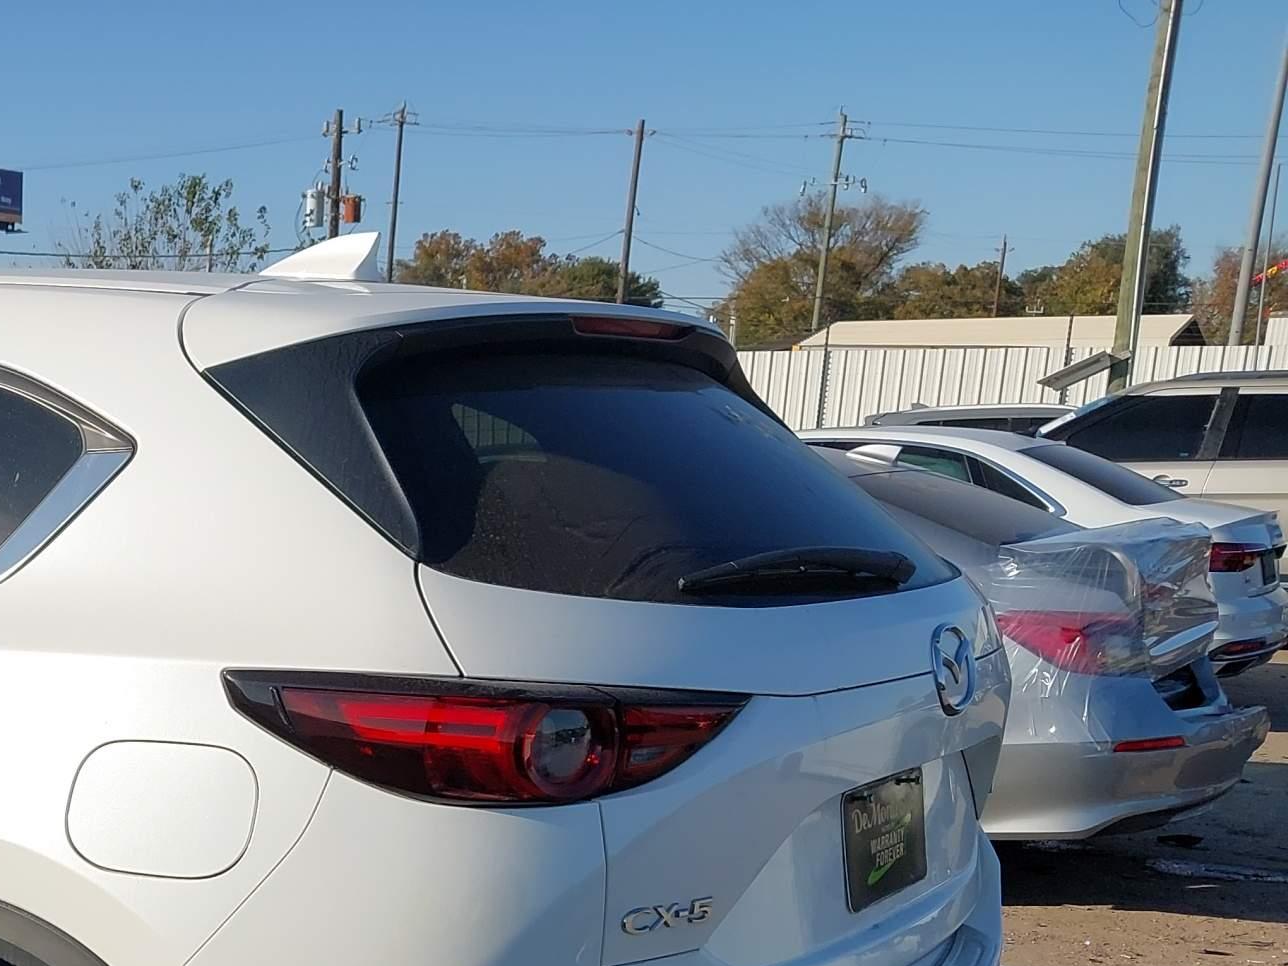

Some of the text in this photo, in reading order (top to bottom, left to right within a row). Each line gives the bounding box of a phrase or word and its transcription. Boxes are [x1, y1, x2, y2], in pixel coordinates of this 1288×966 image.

[870, 827, 904, 854] WARRANTY
[876, 842, 904, 868] FOREVER
[621, 896, 713, 935] CX-5
